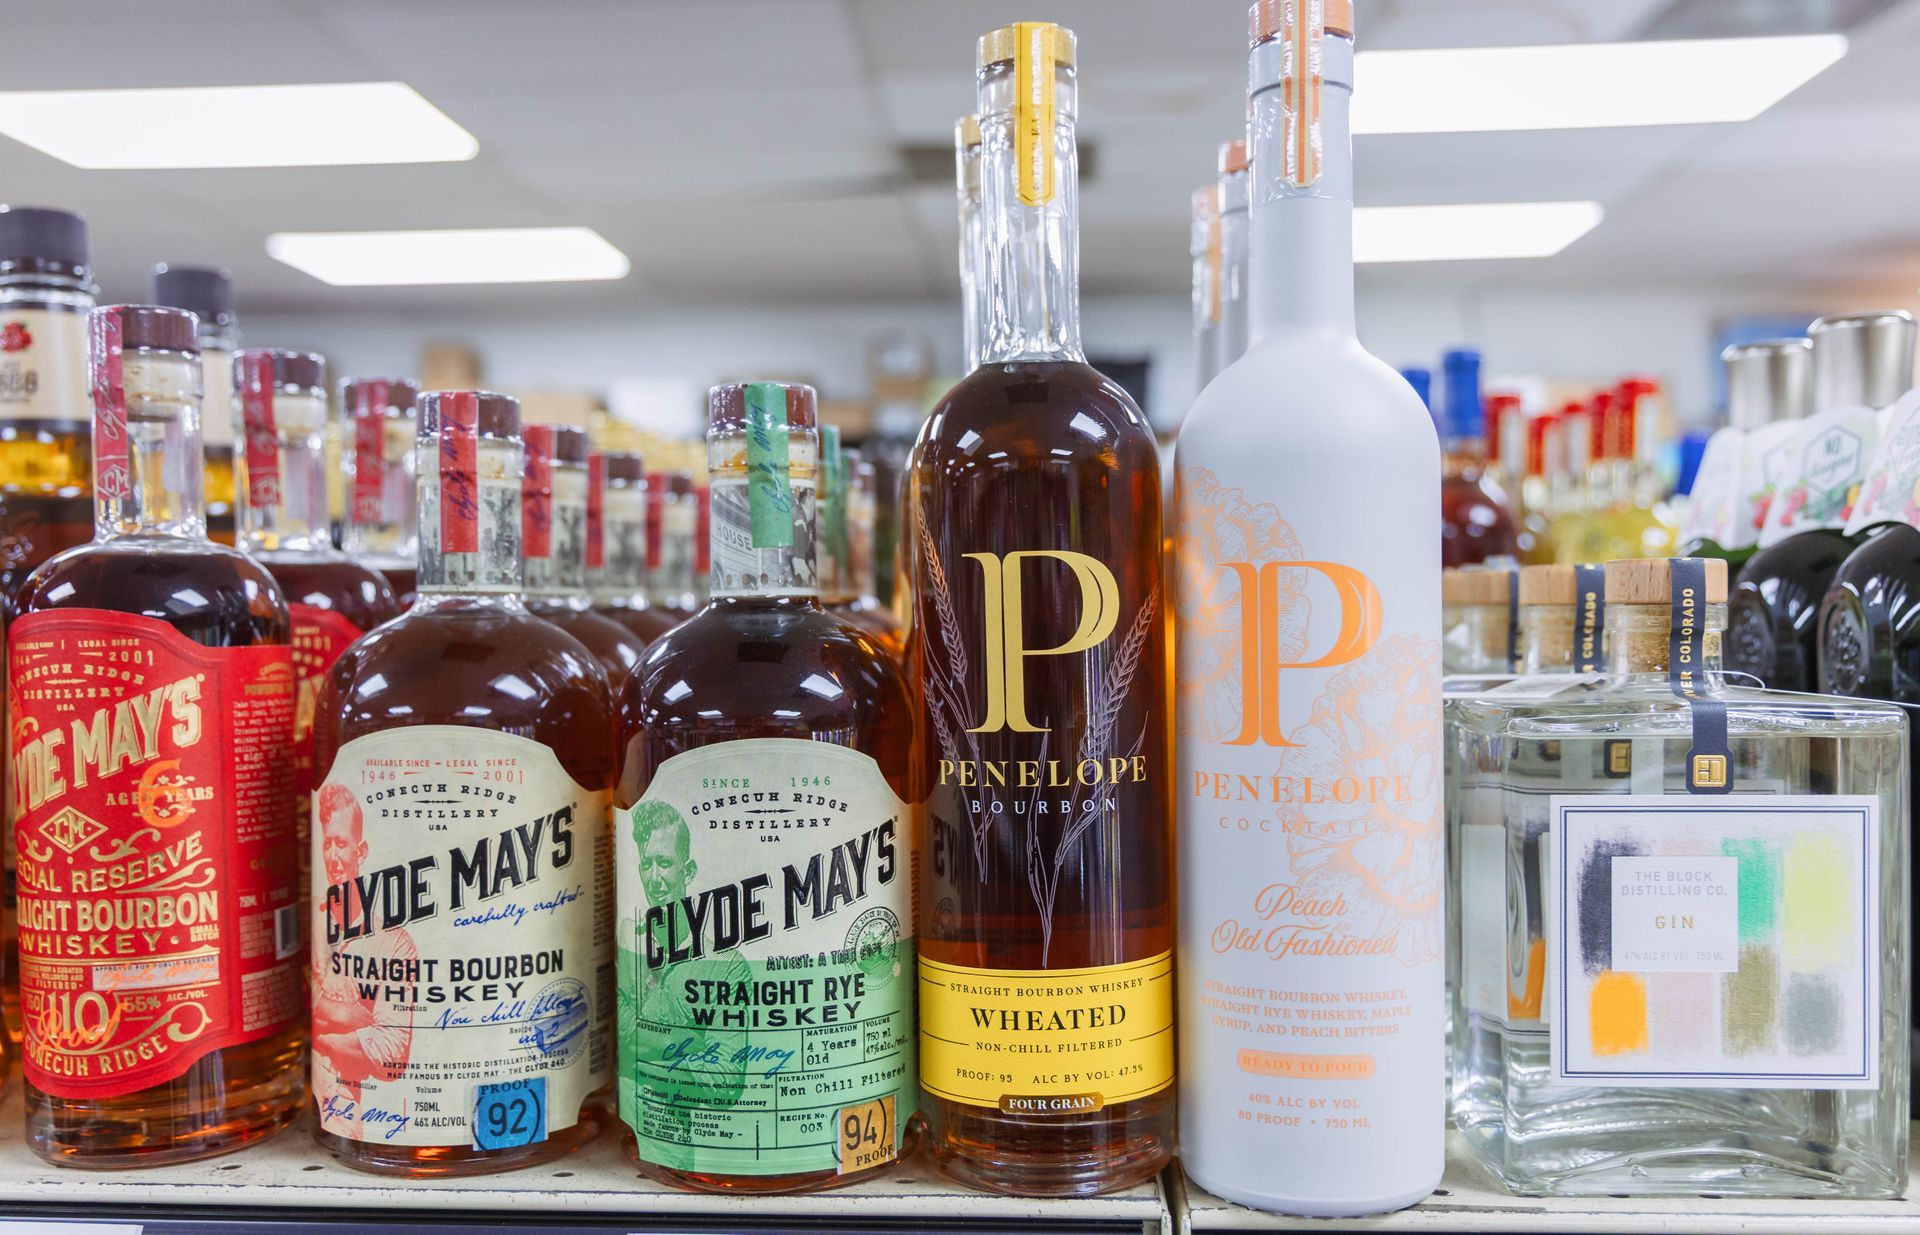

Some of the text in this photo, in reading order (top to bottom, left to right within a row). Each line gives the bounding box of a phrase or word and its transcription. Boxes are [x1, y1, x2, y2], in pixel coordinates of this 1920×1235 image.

[1679, 588, 1695, 664] COLORADO
[962, 550, 1120, 733] P
[108, 650, 154, 667] 2001
[1216, 561, 1383, 747] P
[83, 664, 145, 685] RIDGE
[23, 687, 125, 700] DISTILLERY
[71, 676, 202, 791] MAY'S
[406, 760, 430, 768] SINCE
[446, 760, 479, 768] LEGAL
[486, 758, 517, 766] SINCE
[938, 755, 1148, 789] PENELOPE
[361, 770, 524, 784] 1946 2001
[702, 776, 831, 789] SINCE 1946
[366, 783, 517, 805] CONECUH RIDGE
[1191, 770, 1412, 805] PENELOPE
[692, 792, 849, 816] CONECUH RIDGE
[971, 797, 1117, 815] BOURBON
[382, 809, 500, 818] DISTILLERY
[710, 817, 832, 829] DISTILLERY
[71, 836, 203, 893] RESERVE
[326, 855, 440, 947] CLYDE
[448, 804, 577, 912] MAY'S
[1634, 871, 1713, 881] THE BLOCK
[646, 873, 773, 971] CLYDE
[781, 817, 897, 932] MAY'S
[1621, 885, 1728, 896] DISTILLING CO.
[76, 891, 219, 932] BOURBON
[1253, 883, 1349, 922] Peach
[1655, 915, 1694, 929] GIN
[22, 931, 161, 955] WHISKEY
[1210, 918, 1401, 961] Old Fashioned
[818, 952, 827, 966] A
[1643, 952, 1659, 960] ALC
[332, 948, 565, 984] STRAIGHT BOURBON
[358, 981, 525, 1003] WHISKEY
[684, 973, 866, 1006] STRAIGHT RYE
[950, 977, 1144, 997] STRAIGHT BOURBON WHISKEY
[1203, 979, 1265, 1001] STRAIGHT
[1269, 990, 1341, 1004] BOURBON
[47, 992, 109, 1039] 110
[691, 1001, 862, 1028] WHISKEY
[1200, 995, 1260, 1018] STRAIGHT
[1263, 1006, 1292, 1019] RYE
[1371, 1004, 1413, 1019] MAPLE
[866, 1017, 890, 1027] VOLUME
[969, 1004, 1127, 1032] WHEATED
[806, 1024, 858, 1036] MATURATION
[866, 1031, 879, 1042] 750
[1256, 1023, 1400, 1038] AND PEACH BITTERS
[806, 1038, 857, 1052] 4 Years
[975, 1038, 1123, 1054] NON-CHILL FILTERED
[25, 1035, 169, 1076] CONECUH RIDGE
[806, 1053, 829, 1066] Old
[1242, 1055, 1368, 1073] READY TO POUR
[424, 1061, 440, 1070] THE
[443, 1060, 480, 1069] HISTORIC
[956, 1063, 1144, 1084] PROOF: 95 ALC BY VOL: 47.5%
[387, 1072, 407, 1080] MADE
[457, 1072, 480, 1080] CLYDE
[484, 1070, 499, 1078] MAY
[779, 1073, 825, 1082] FILTRATION
[779, 1063, 906, 1098] Non Chill Filtered
[416, 1086, 442, 1094] Volume
[480, 1078, 530, 1096] PROOF
[414, 1101, 440, 1112] 750ML
[1008, 1096, 1096, 1111] FOUR GRAIN
[1248, 1093, 1360, 1109] 40% ALC BY VOL
[414, 1116, 467, 1127] 46% ALC/VOL
[488, 1098, 528, 1137] 92
[688, 1121, 719, 1130] process
[694, 1112, 732, 1121] historic
[779, 1113, 812, 1122] RECIPE
[1238, 1109, 1372, 1129] 80 PROOF 750 ML
[694, 1128, 734, 1139] Clyde May
[800, 1122, 823, 1133] 003
[844, 1108, 878, 1151] 94
[855, 1143, 894, 1166] PROOF
